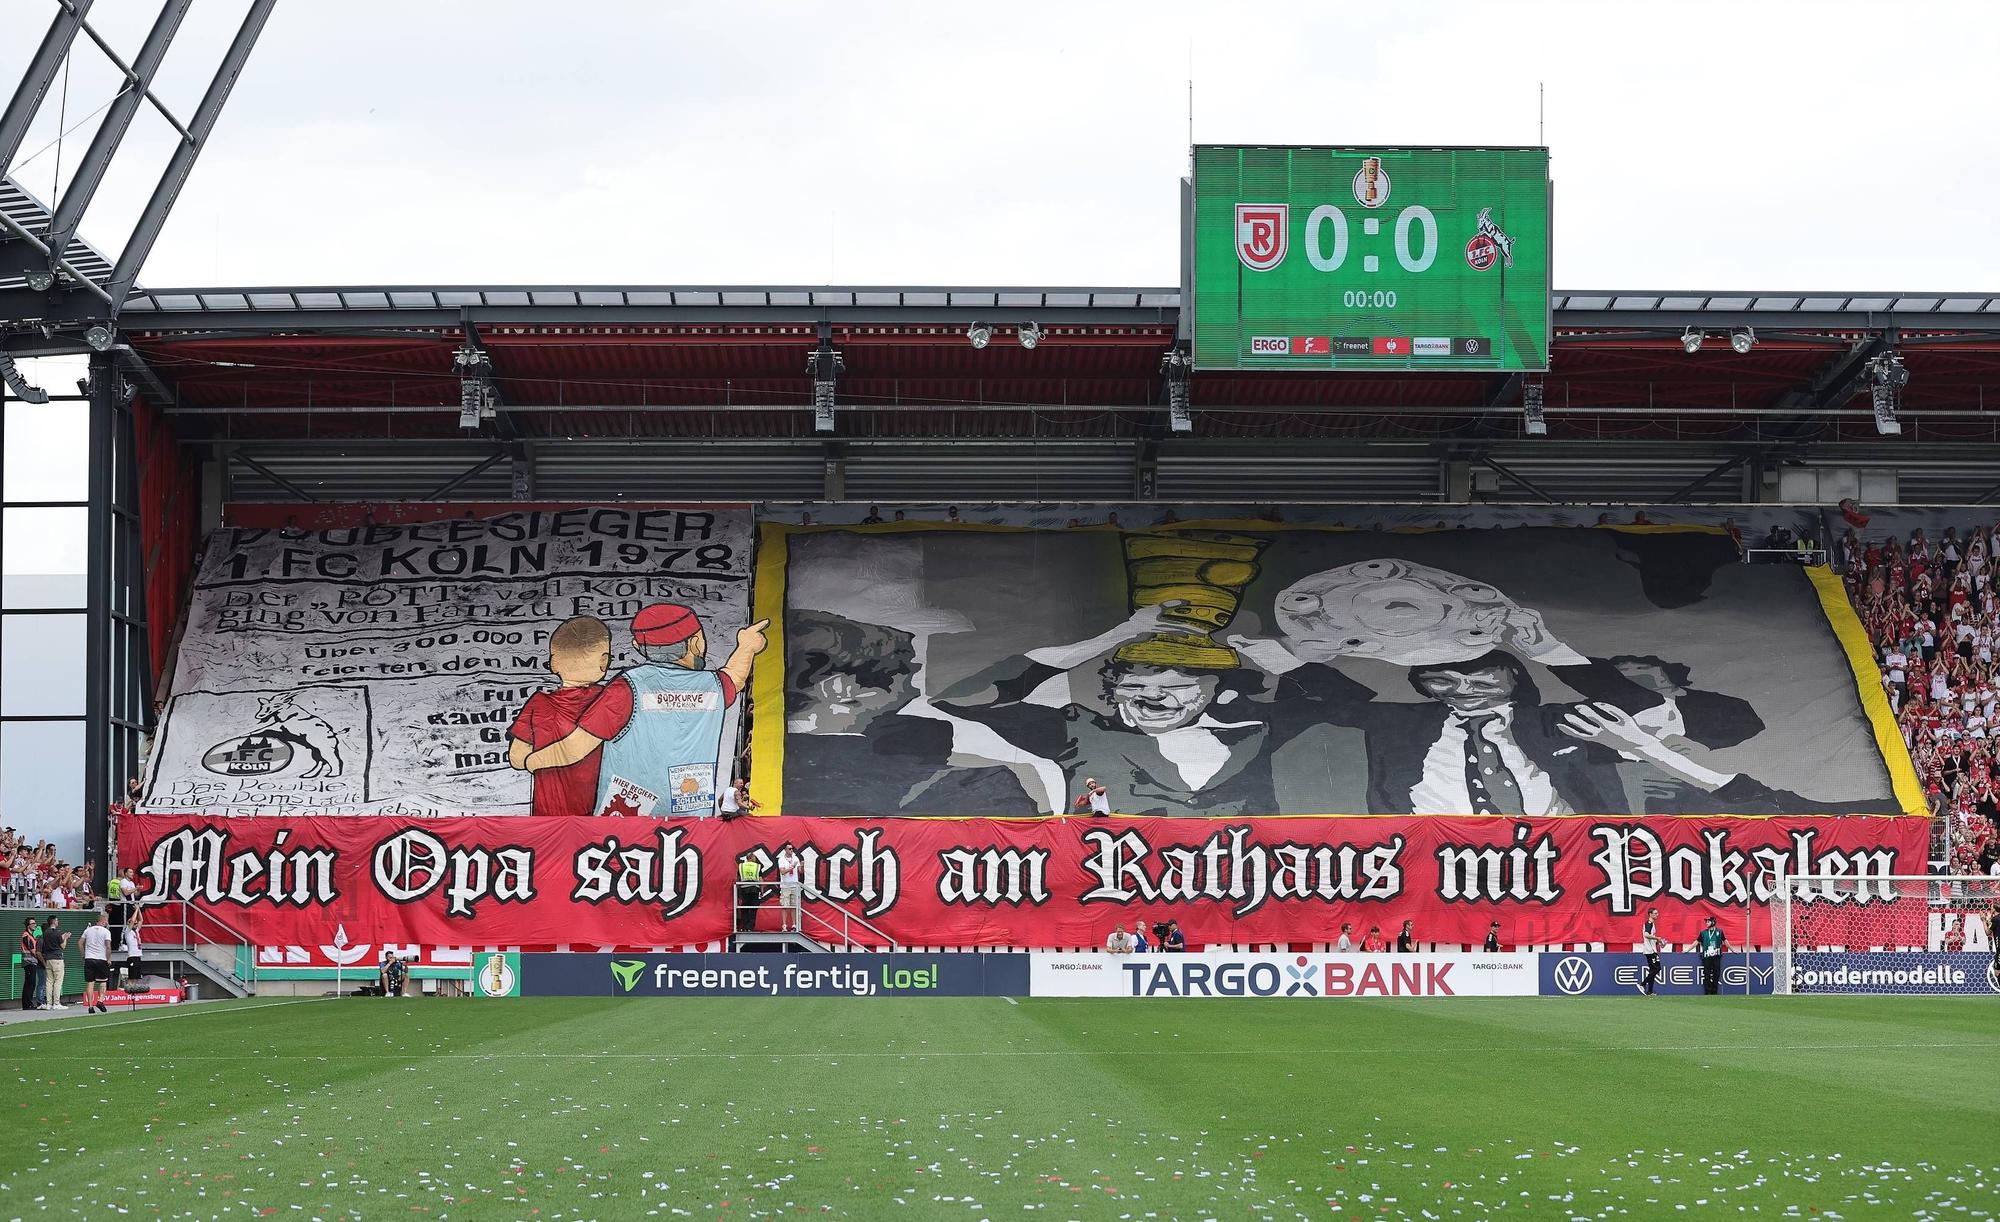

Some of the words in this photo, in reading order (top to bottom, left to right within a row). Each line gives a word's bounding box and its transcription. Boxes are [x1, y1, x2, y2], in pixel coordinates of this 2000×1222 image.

[1304, 204, 1438, 273] 0:0
[1343, 290, 1397, 309] 00:00
[1252, 339, 1287, 351] ERGO
[1343, 341, 1369, 351] freenet
[1143, 484, 1152, 496] 2
[381, 543, 548, 576] KÖLN
[577, 540, 733, 571] 1978
[225, 589, 300, 608] Der
[583, 578, 726, 602] Kölsch
[216, 608, 307, 631] ging
[320, 608, 400, 625] von
[503, 601, 555, 618] zu
[569, 596, 644, 618] Fan
[304, 645, 380, 660] Über
[393, 629, 523, 653] 300.000
[229, 761, 272, 772] KÖLN
[172, 780, 227, 796] Das
[238, 778, 347, 793] Double
[612, 776, 630, 789] HIER
[629, 784, 658, 801] REGIERT
[137, 823, 339, 907] Mein
[371, 826, 538, 920] Opa
[571, 826, 702, 920] sah
[934, 843, 1053, 907] am
[1080, 824, 1407, 919] Rathaus
[1435, 822, 1565, 905] mit
[1589, 824, 1900, 915] Pokalen
[654, 963, 779, 995] freenet,
[783, 963, 877, 995] fertig,
[882, 963, 938, 989] los!
[1790, 965, 1966, 985] Sondermodelle
